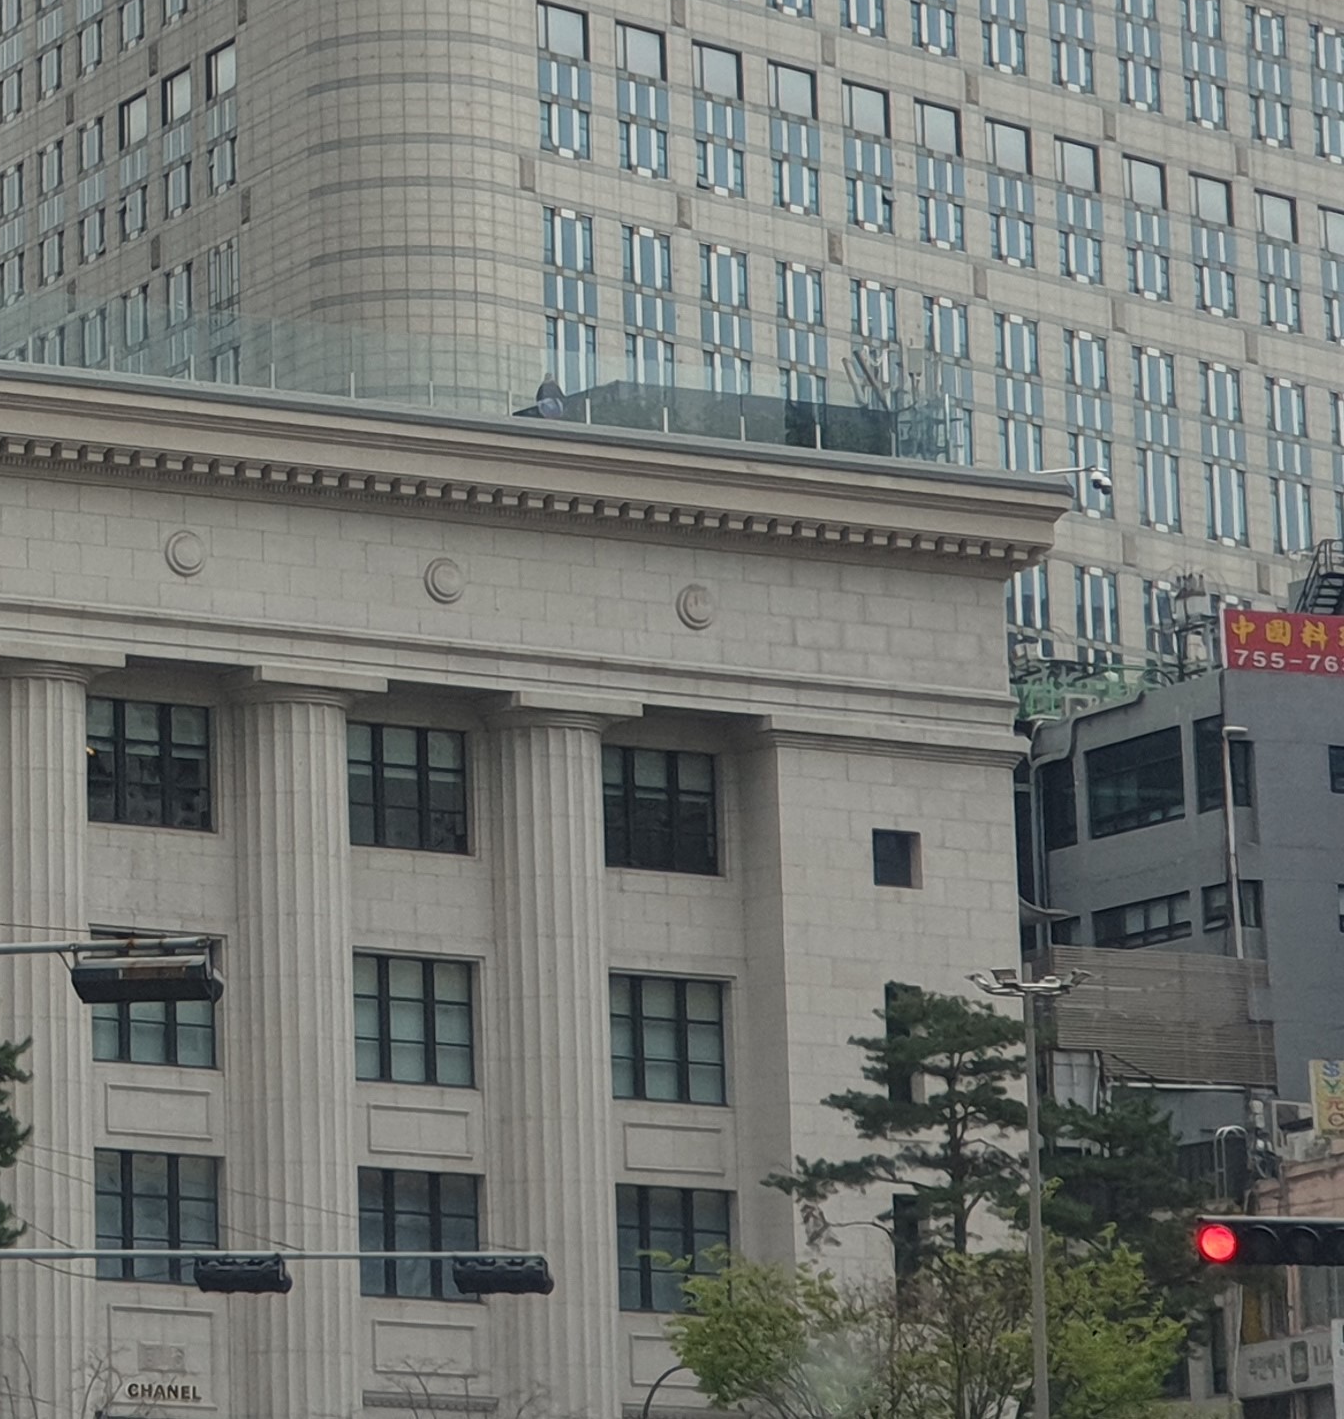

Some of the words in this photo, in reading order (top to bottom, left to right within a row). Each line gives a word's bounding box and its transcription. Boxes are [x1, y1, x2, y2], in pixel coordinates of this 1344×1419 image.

[1230, 614, 1344, 651] 中國料
[1234, 649, 1344, 673] 755-76
[126, 1382, 203, 1401] CHANEL
